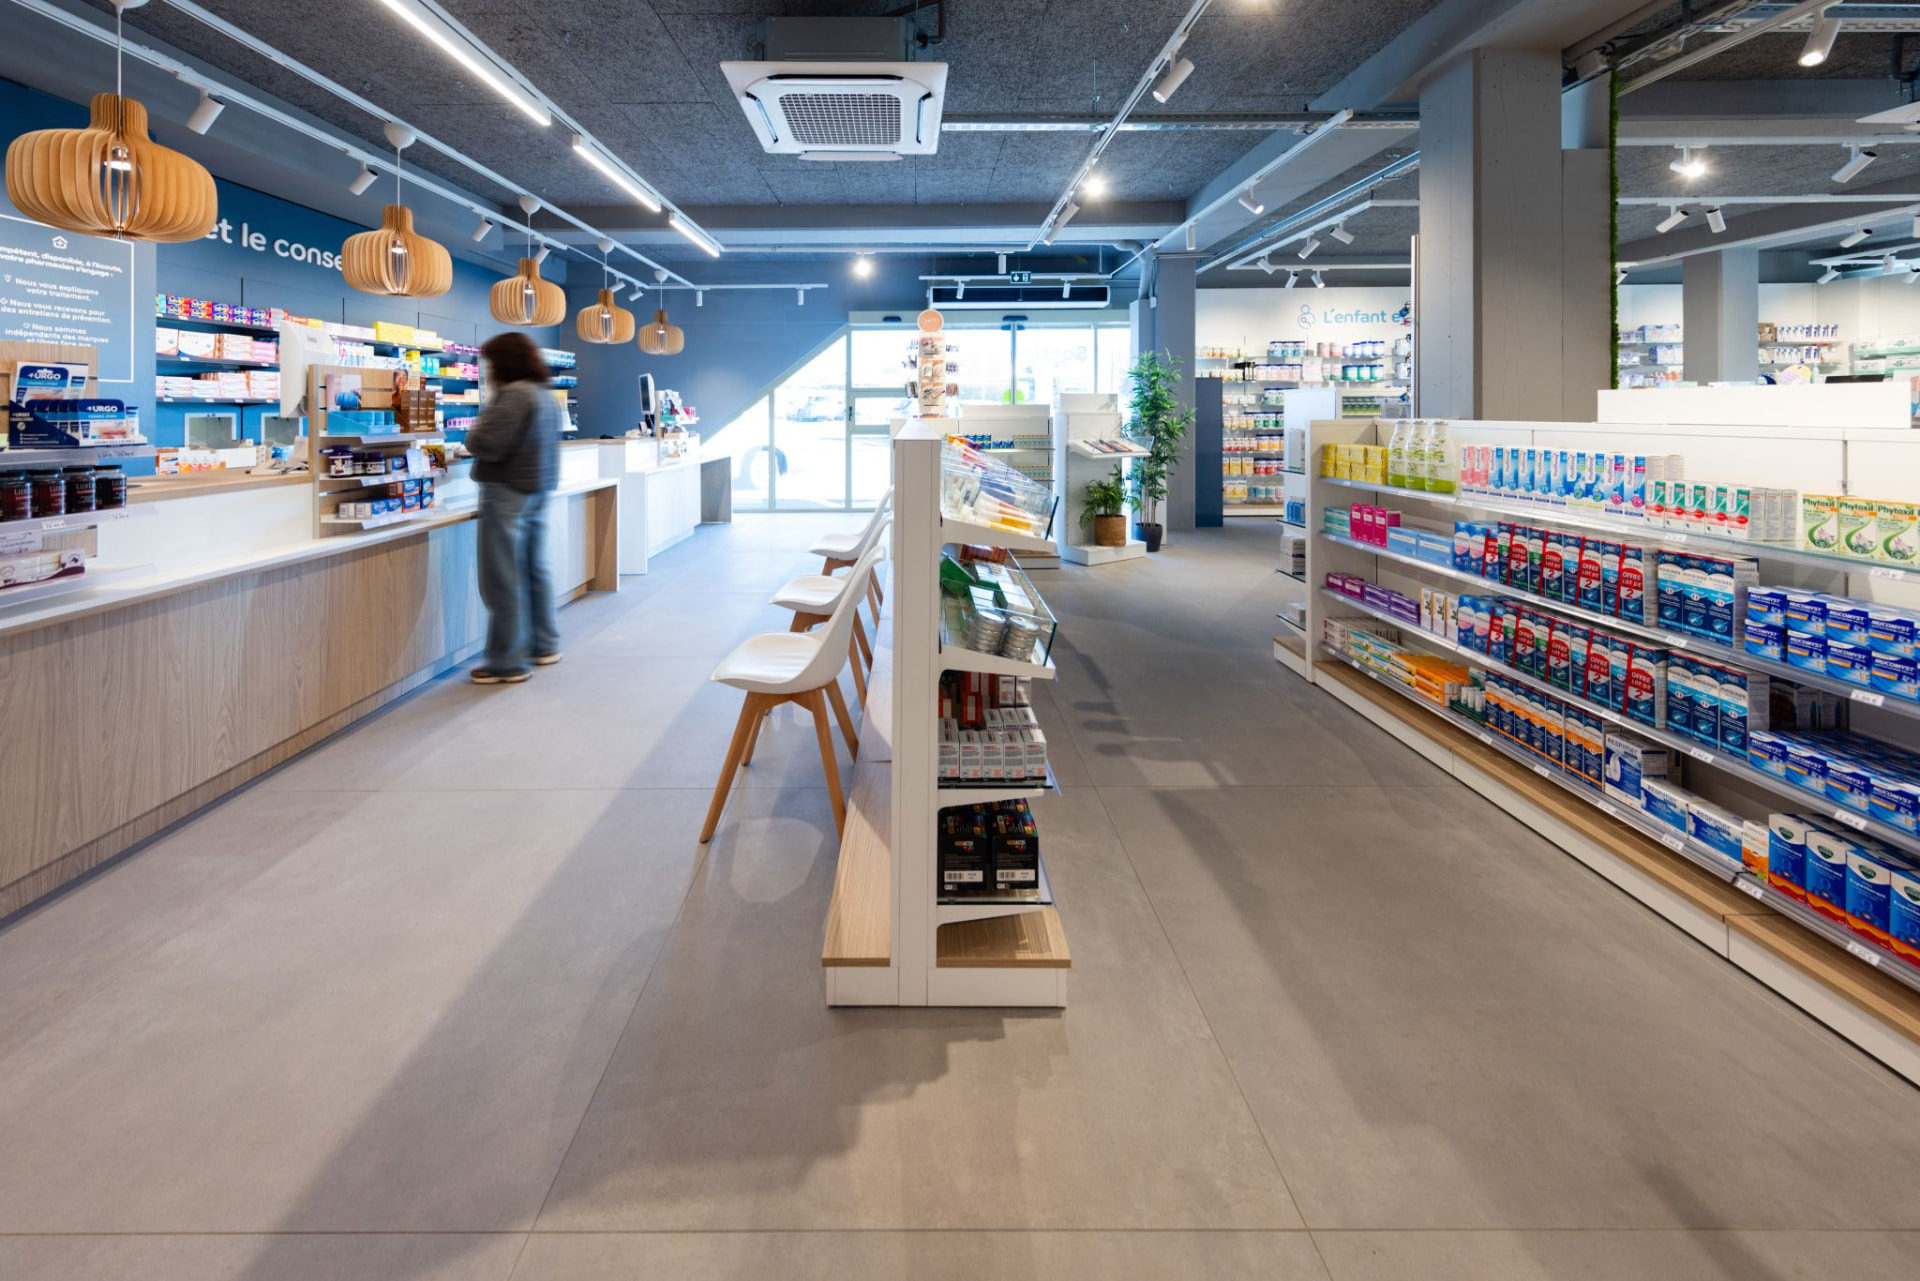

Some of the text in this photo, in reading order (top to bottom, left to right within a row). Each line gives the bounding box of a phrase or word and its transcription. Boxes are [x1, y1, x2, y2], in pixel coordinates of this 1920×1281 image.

[242, 222, 266, 252] le
[274, 239, 342, 272] conse
[16, 278, 99, 295] Nous vous expliquons
[26, 288, 47, 296] votre
[10, 299, 32, 308] Nous
[54, 306, 87, 315] recevons
[89, 309, 105, 317] pour
[18, 309, 60, 318] entretiens
[32, 324, 53, 332] Nous
[34, 372, 61, 380] URGO
[1803, 498, 1834, 508] Phytoxil
[1840, 502, 1874, 512] Phytoxil
[1878, 505, 1914, 516] Phytoxil
[1548, 570, 1555, 578] 2
[1622, 572, 1641, 580] OFFRE
[1584, 579, 1592, 588] 2
[1626, 588, 1634, 598] 2
[1750, 593, 1781, 604] MUCOMYST
[1789, 601, 1822, 612] MUCOMYST
[1829, 610, 1866, 622] MUCOMYST
[1872, 619, 1911, 632] MUCOMYST
[1747, 626, 1778, 637] MUCOMYST
[1790, 637, 1824, 648] MUCOMYST
[1521, 645, 1527, 654] 2
[1830, 647, 1867, 660] MUCOMYST
[1555, 658, 1562, 668] 2
[1591, 657, 1608, 667] OFFRE
[1875, 658, 1915, 672] MUCOMYST
[1593, 673, 1601, 682] 2
[1632, 672, 1651, 682] OFFRE
[1634, 690, 1643, 700] 2
[1752, 739, 1782, 754] MUCOMYST
[1789, 753, 1823, 768] MUCOMYST
[1830, 769, 1866, 786] MUCOMYST
[1873, 786, 1913, 804] MUCOMYST
